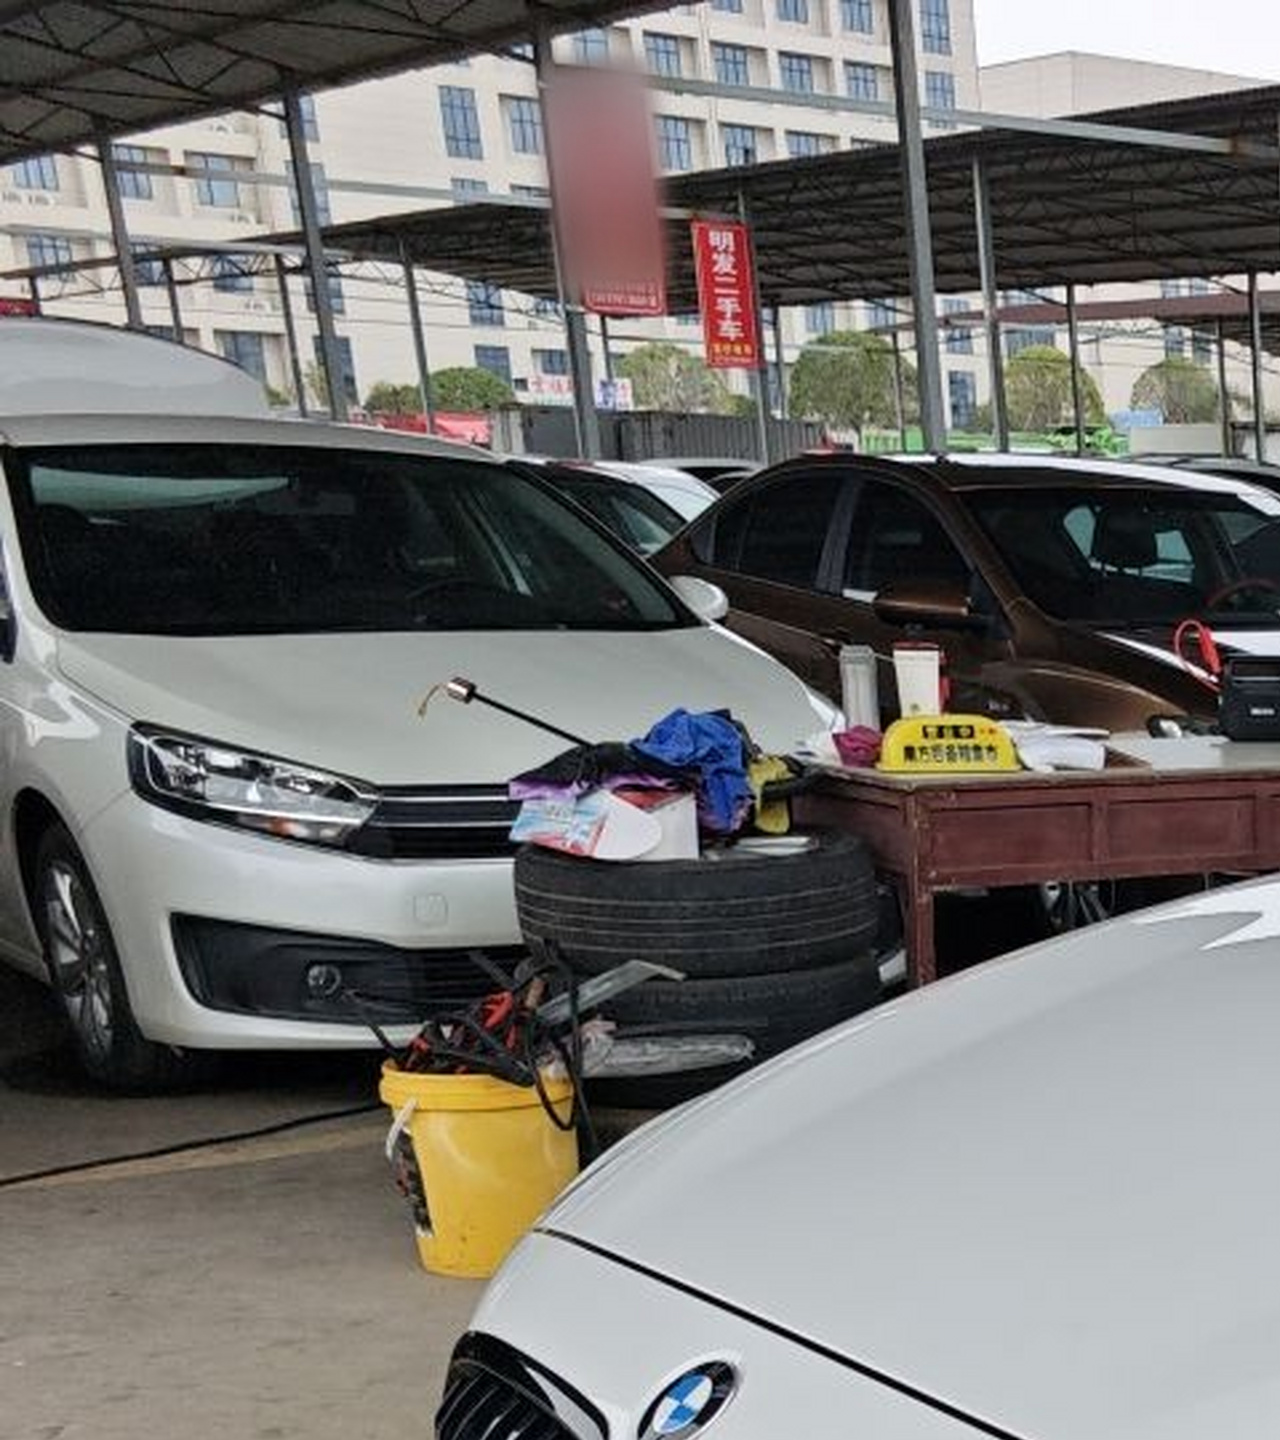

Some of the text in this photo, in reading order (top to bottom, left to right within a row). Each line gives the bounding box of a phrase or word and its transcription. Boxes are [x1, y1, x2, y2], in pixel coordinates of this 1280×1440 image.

[708, 230, 745, 342] 明发二手车
